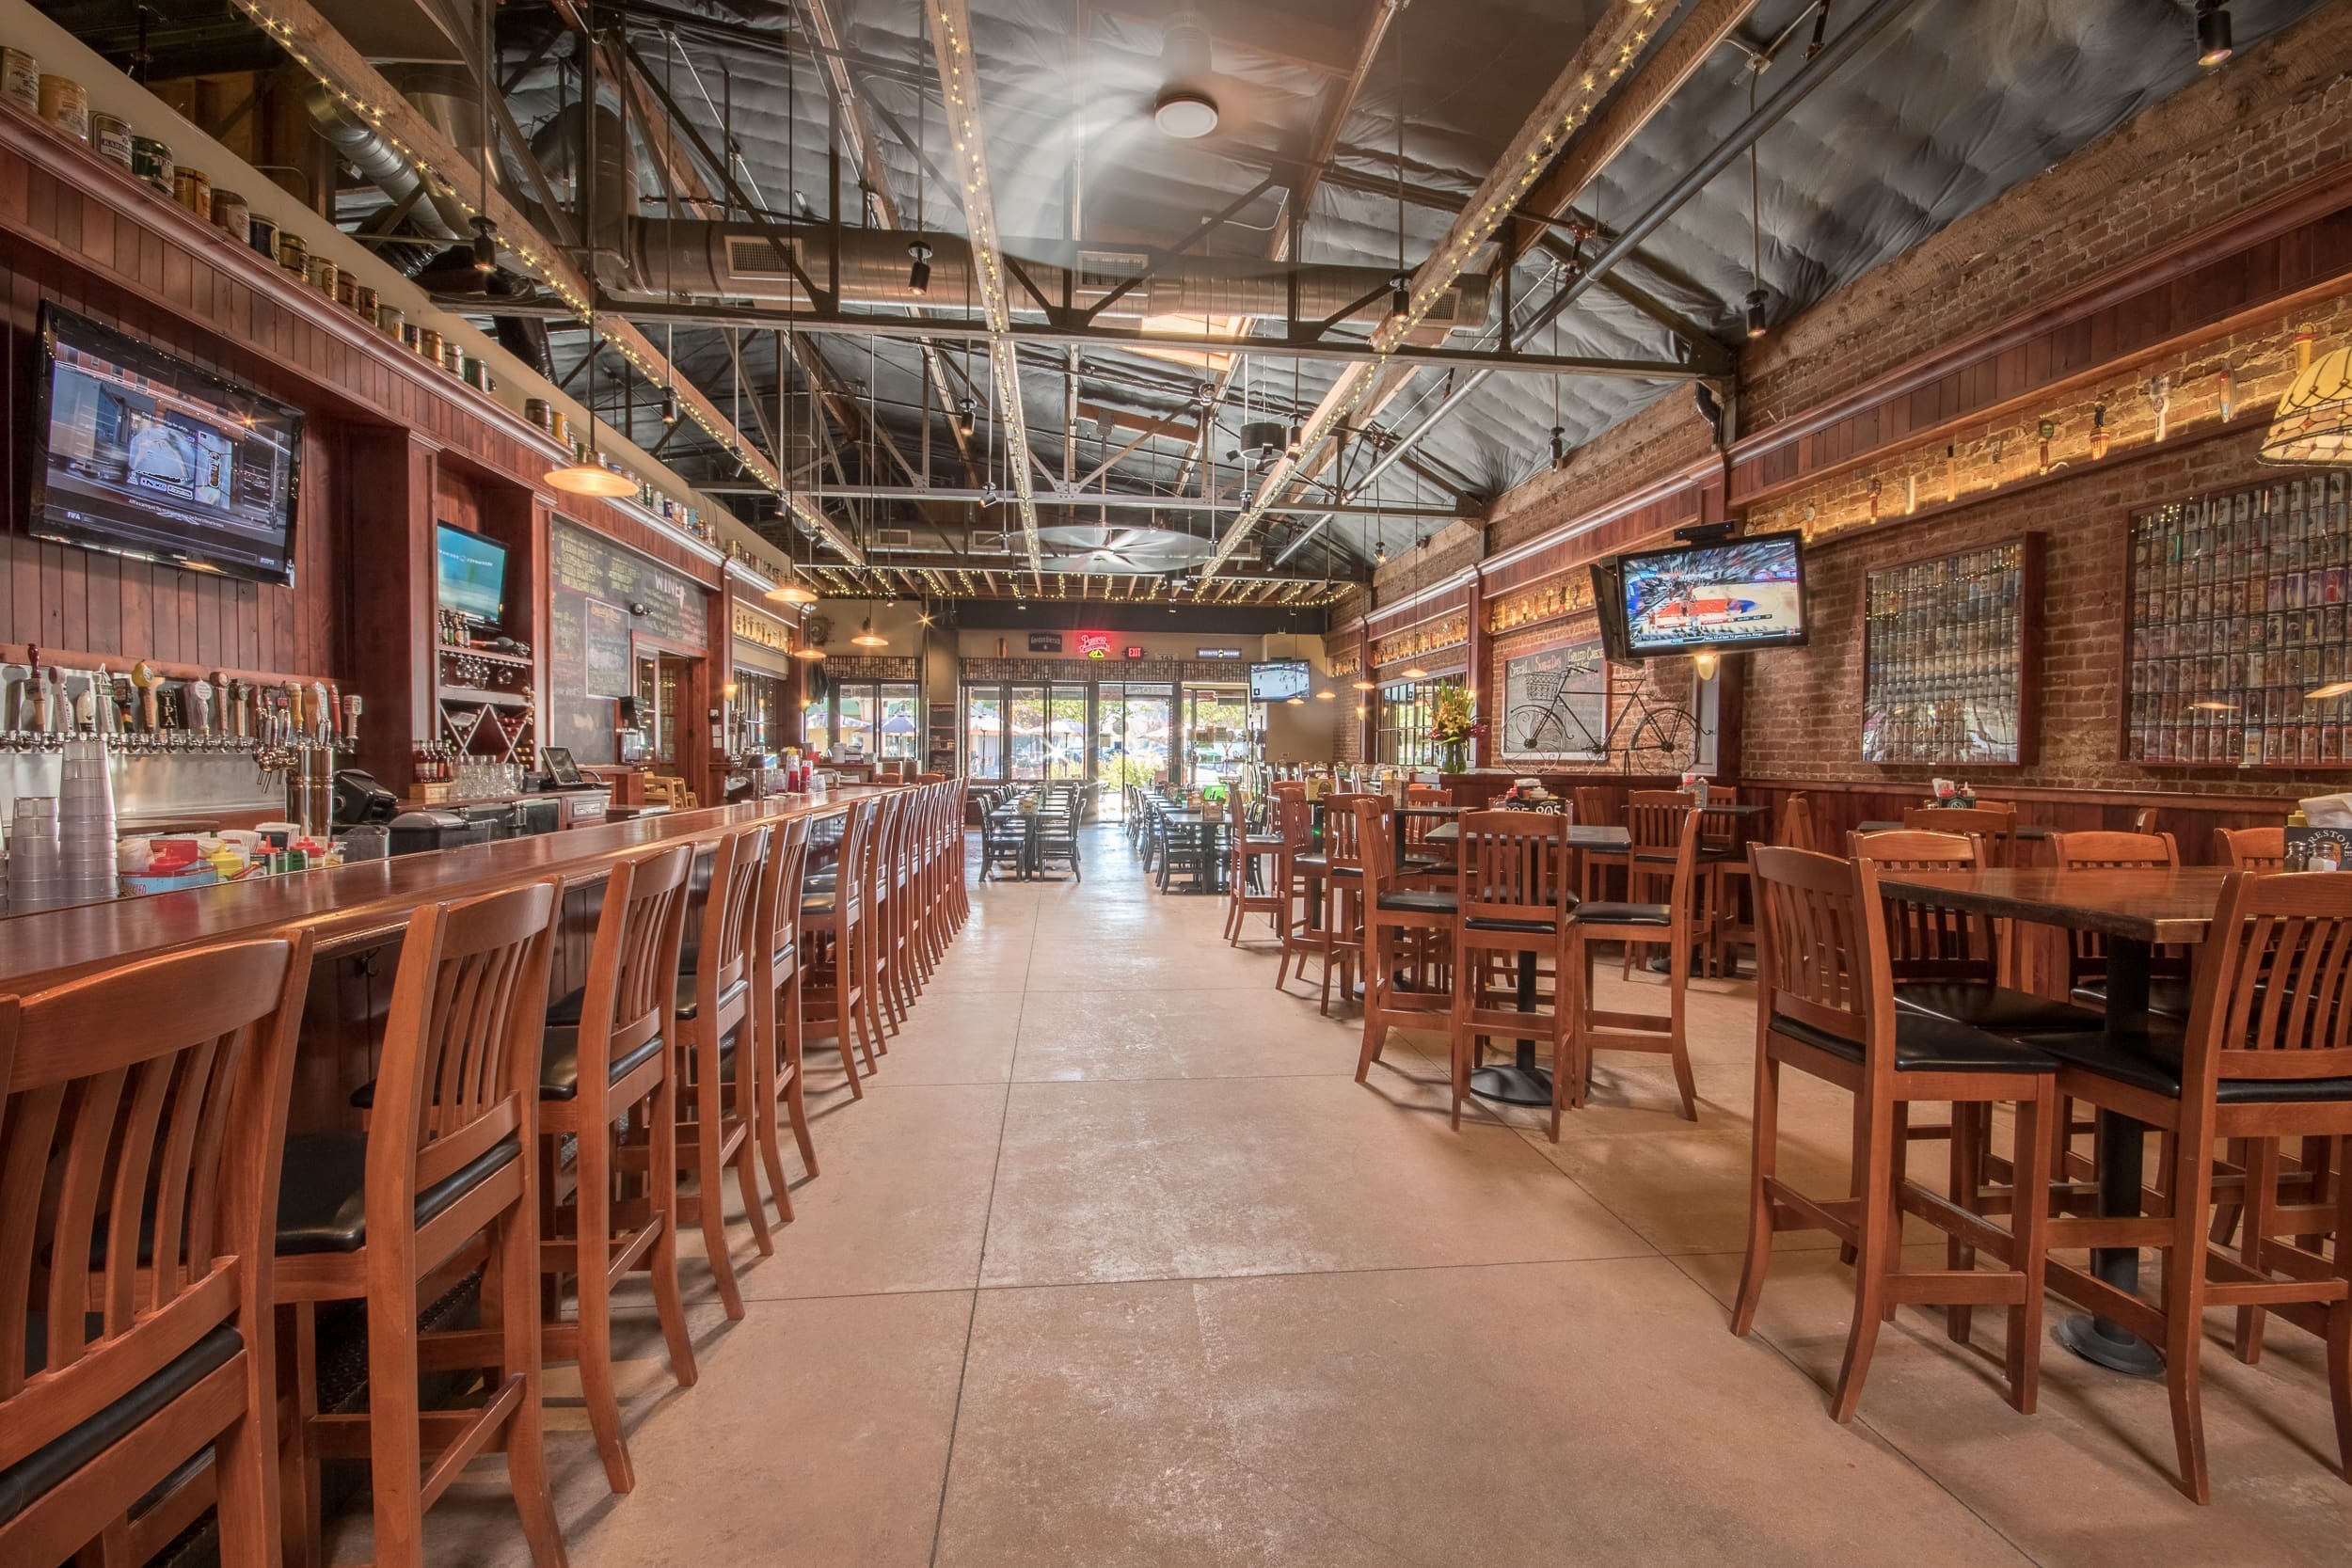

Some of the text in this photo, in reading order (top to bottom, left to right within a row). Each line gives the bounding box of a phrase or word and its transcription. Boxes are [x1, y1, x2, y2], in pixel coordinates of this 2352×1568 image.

[67, 511, 81, 520] FIFA
[1128, 647, 1141, 657] EXIT
[165, 696, 176, 726] IPA
